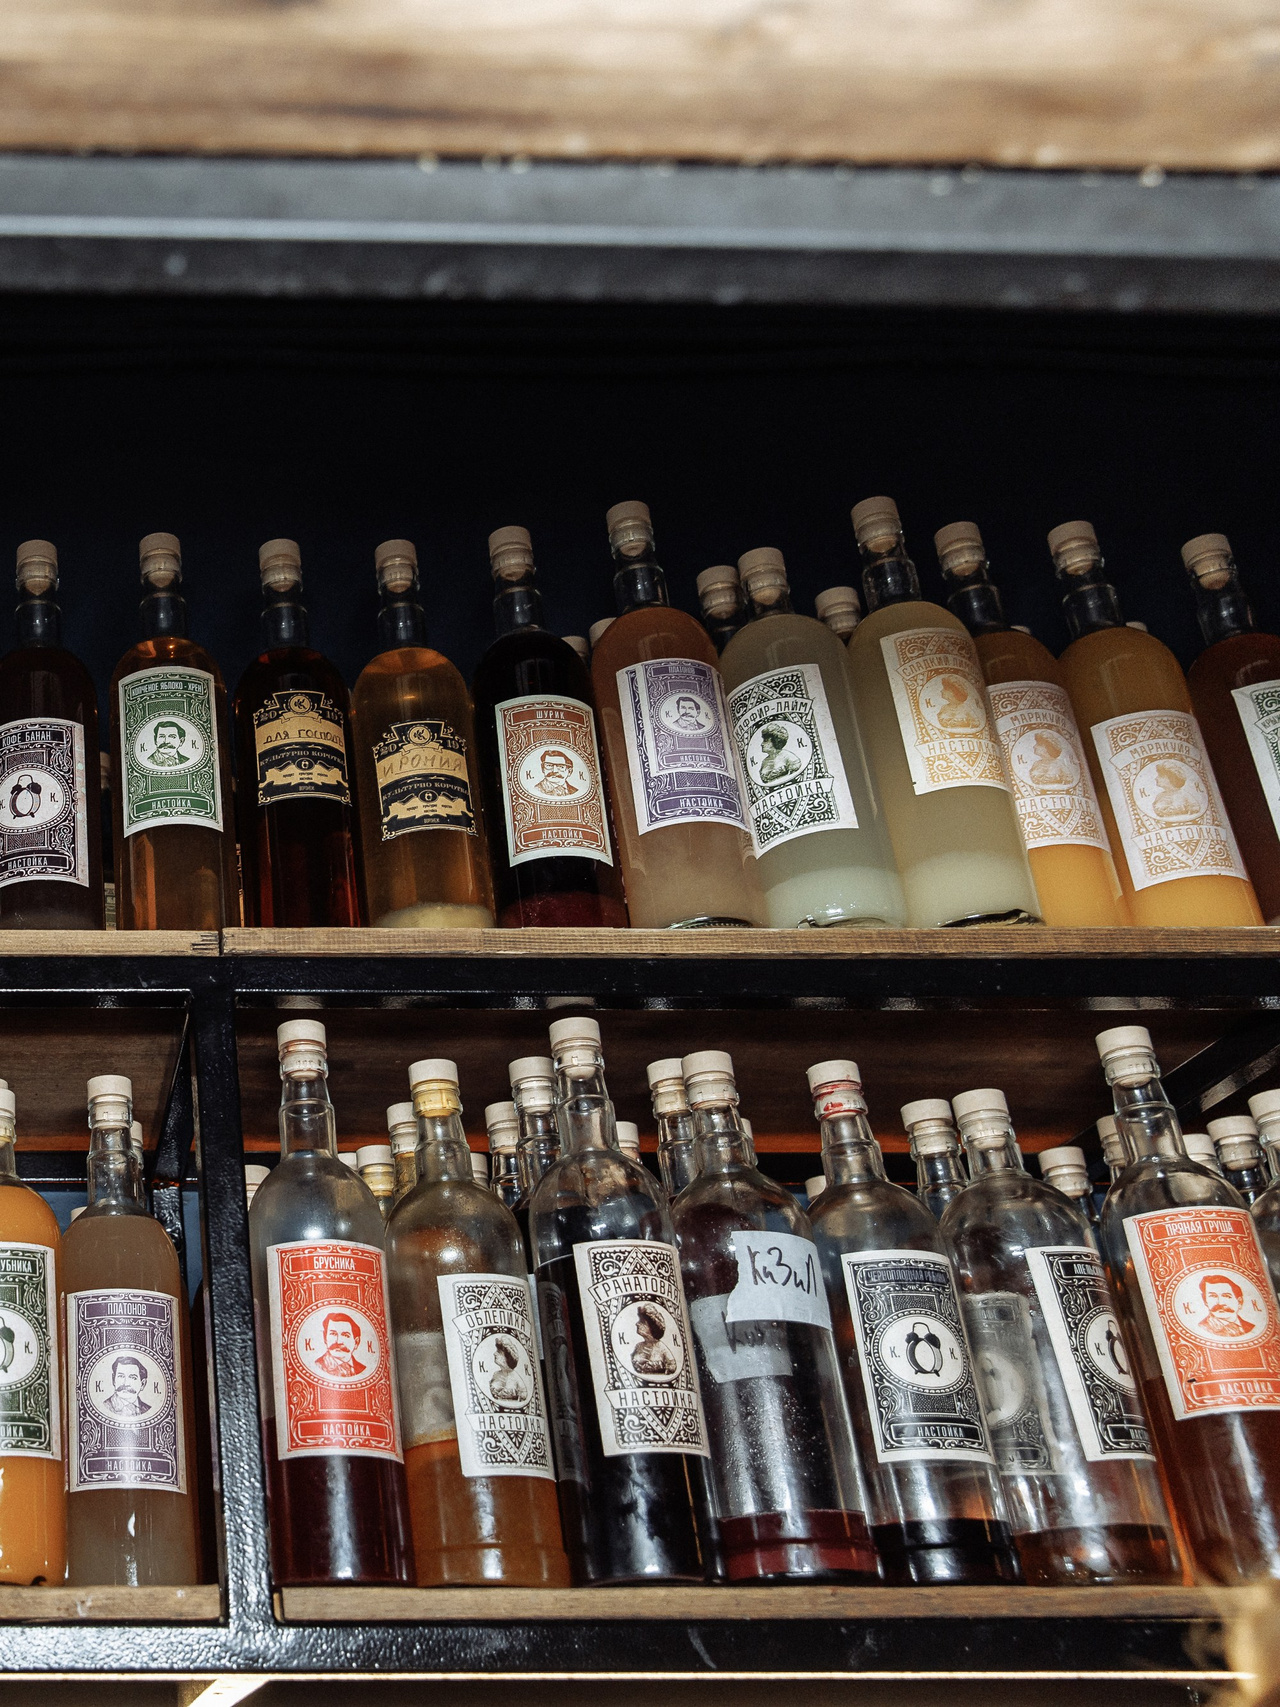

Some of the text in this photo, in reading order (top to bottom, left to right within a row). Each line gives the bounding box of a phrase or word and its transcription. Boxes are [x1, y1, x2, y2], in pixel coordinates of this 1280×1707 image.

[902, 655, 951, 677] СЛАДКИЙ
[132, 683, 159, 696] КОПЧЕНОЕ
[160, 681, 183, 691] ЯБЛОКО
[187, 683, 203, 693] ХРЕН
[535, 710, 566, 720] ШУРИК
[735, 699, 809, 737] КАФФИР-ЛАЙМ
[2, 730, 52, 748] КОФЕ БАНАН
[263, 730, 290, 745] ДЛЯ
[1129, 740, 1191, 760] МАРАКУЙЯ
[383, 753, 462, 778] ИРОНИЯ
[151, 797, 192, 811] НАСТОЙКА
[679, 796, 724, 810] НАСТОЙКА
[754, 779, 824, 814] НАСТОЙКА
[542, 828, 584, 840] НАСТОЙКА
[1143, 827, 1222, 848] НАСТОЙКА
[7, 856, 49, 870] НАСТОЙКА
[1165, 1219, 1235, 1236] ПРЯНАЯ ГРУША
[313, 1256, 356, 1271] БРУСНИКА
[593, 1275, 680, 1304] ГРАНАТОВАЯ
[106, 1301, 148, 1317] ПЛАТОНОВ
[465, 1308, 527, 1333] ОБЛЕПИХА
[1218, 1378, 1275, 1395] НАСТОЙКА
[618, 1387, 694, 1407] НАСТОЙКА
[321, 1420, 372, 1437] НАСТОЙКА
[477, 1411, 542, 1432] НАСТОЙКА
[916, 1423, 965, 1439] НАСТОЙКА
